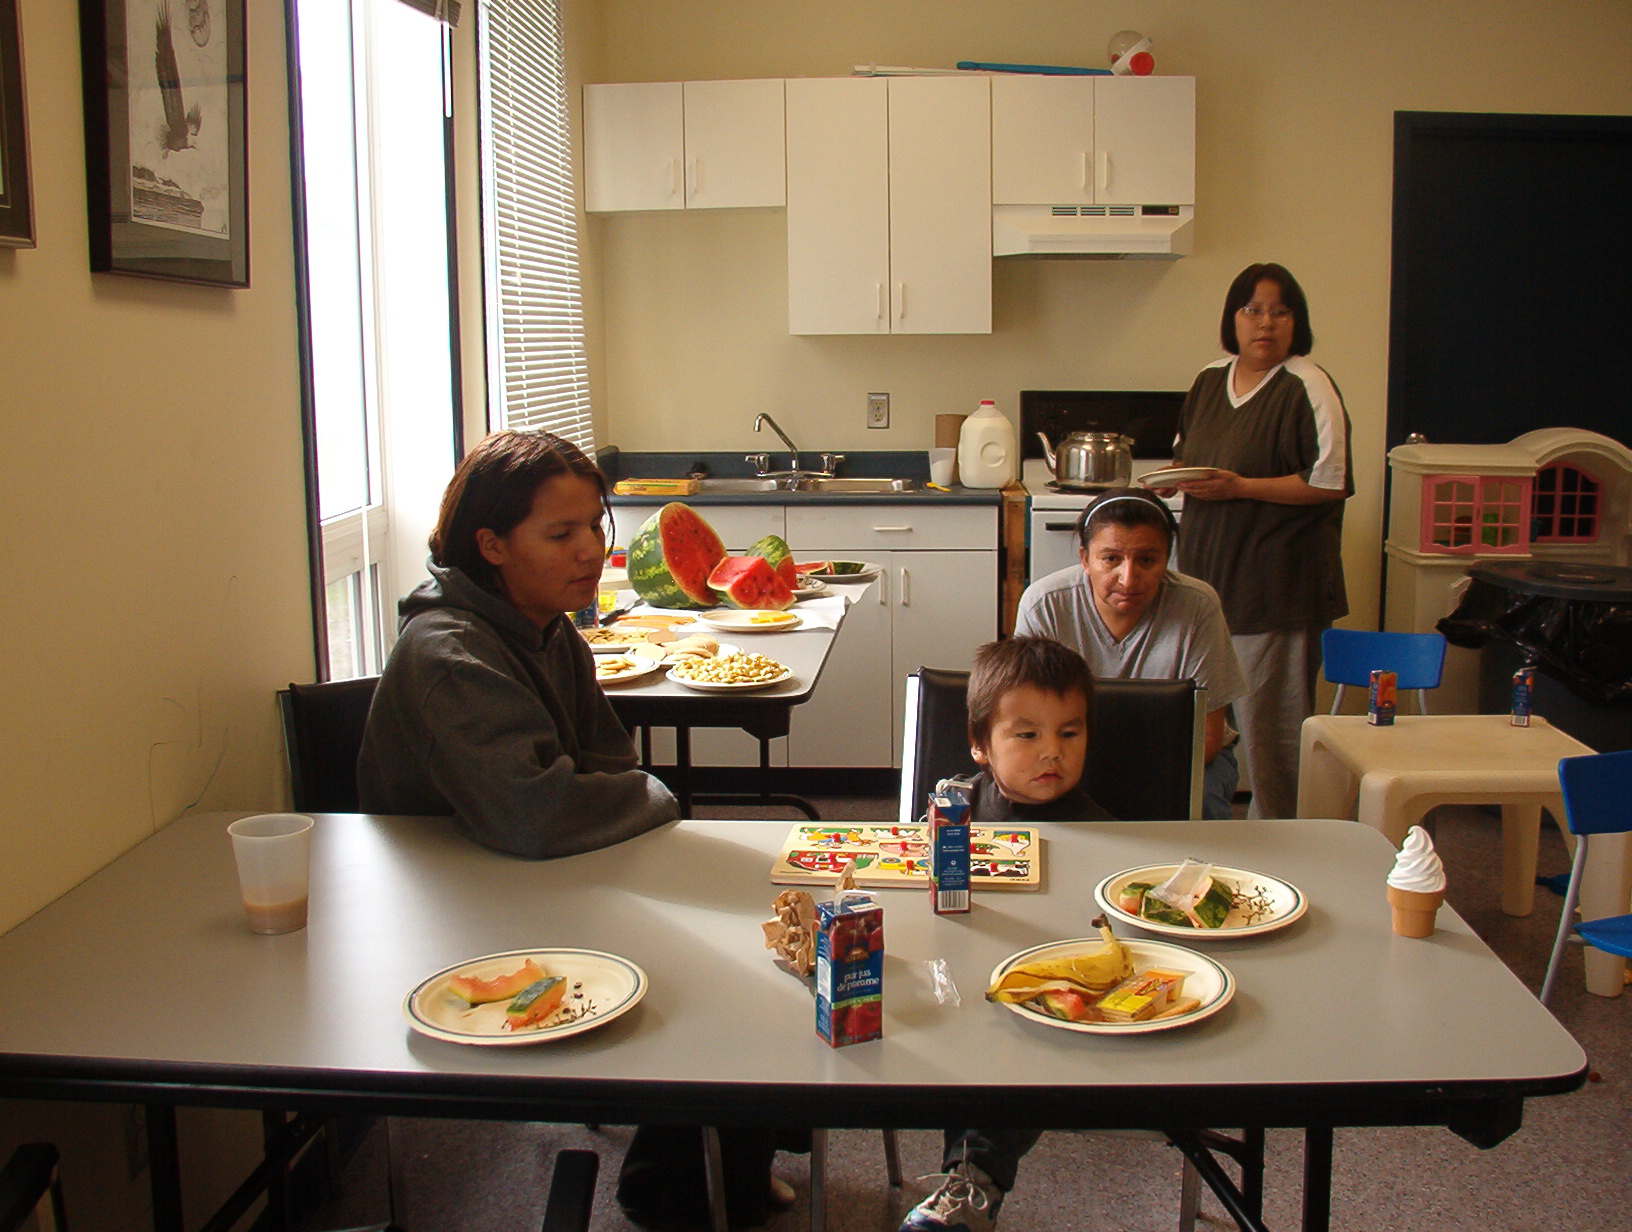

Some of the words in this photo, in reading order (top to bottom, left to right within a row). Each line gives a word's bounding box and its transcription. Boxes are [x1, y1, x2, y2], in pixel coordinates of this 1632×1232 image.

[844, 972, 857, 983] pur
[858, 968, 871, 980] jus
[837, 982, 846, 992] de
[847, 977, 880, 991] pomme
